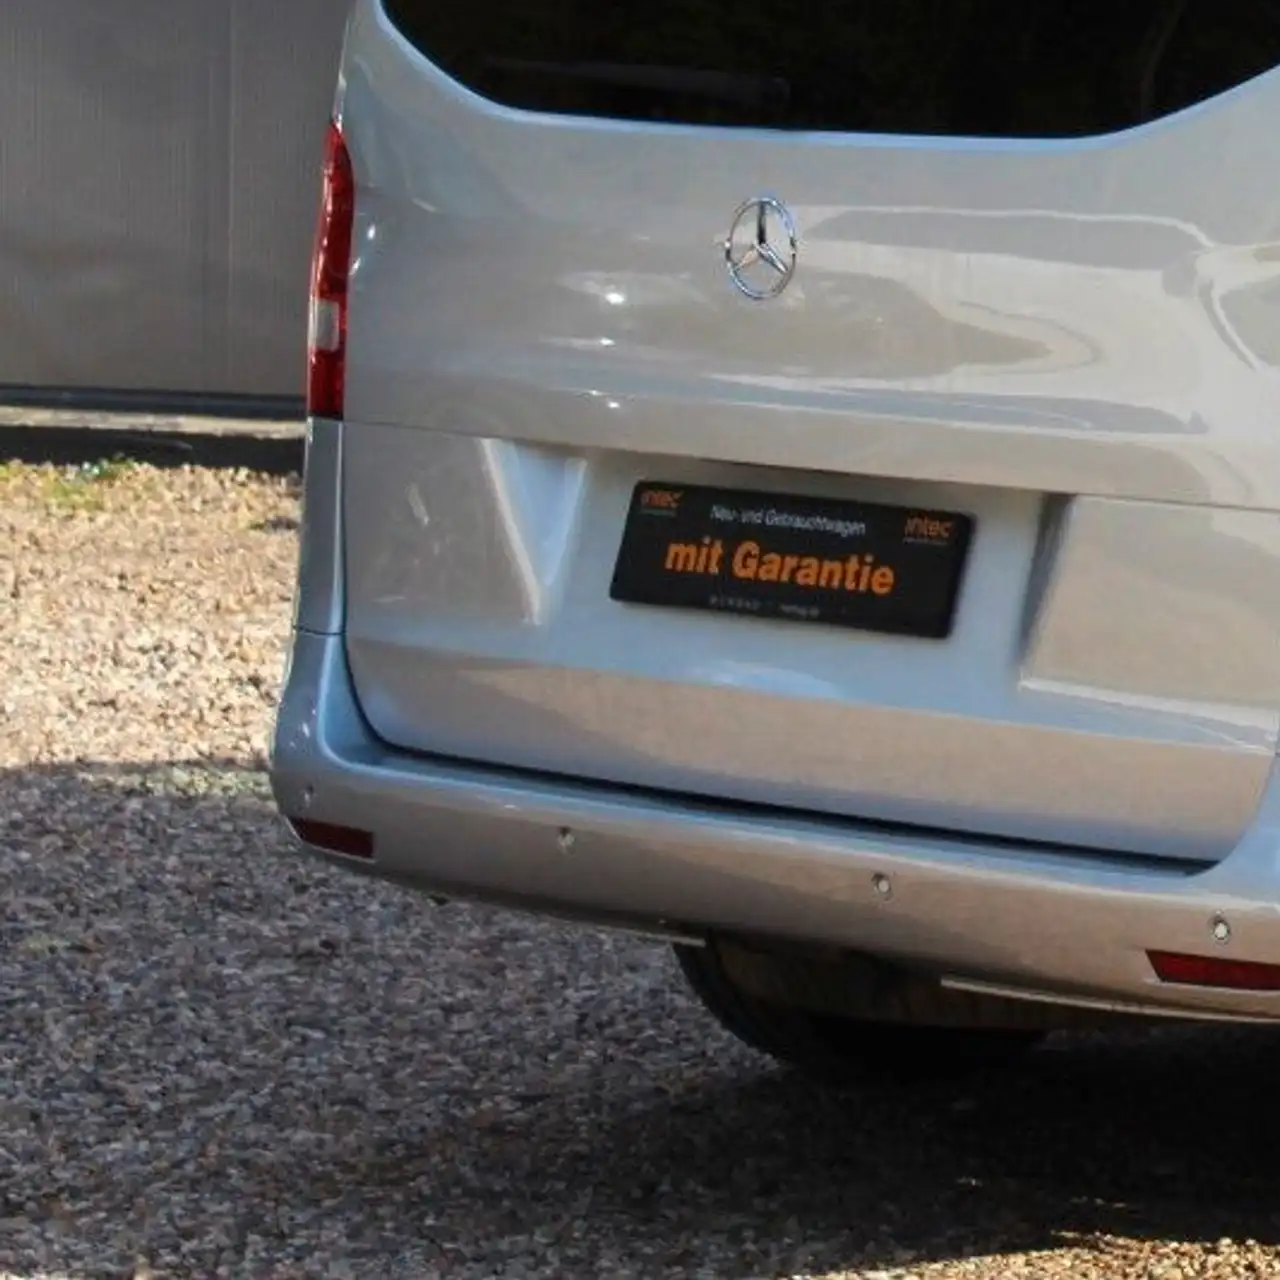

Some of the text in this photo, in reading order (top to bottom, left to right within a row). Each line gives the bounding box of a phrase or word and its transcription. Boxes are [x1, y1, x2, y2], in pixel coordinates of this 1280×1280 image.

[764, 508, 867, 538] Gebrauchtwagen
[664, 535, 897, 595] mit Garantie
